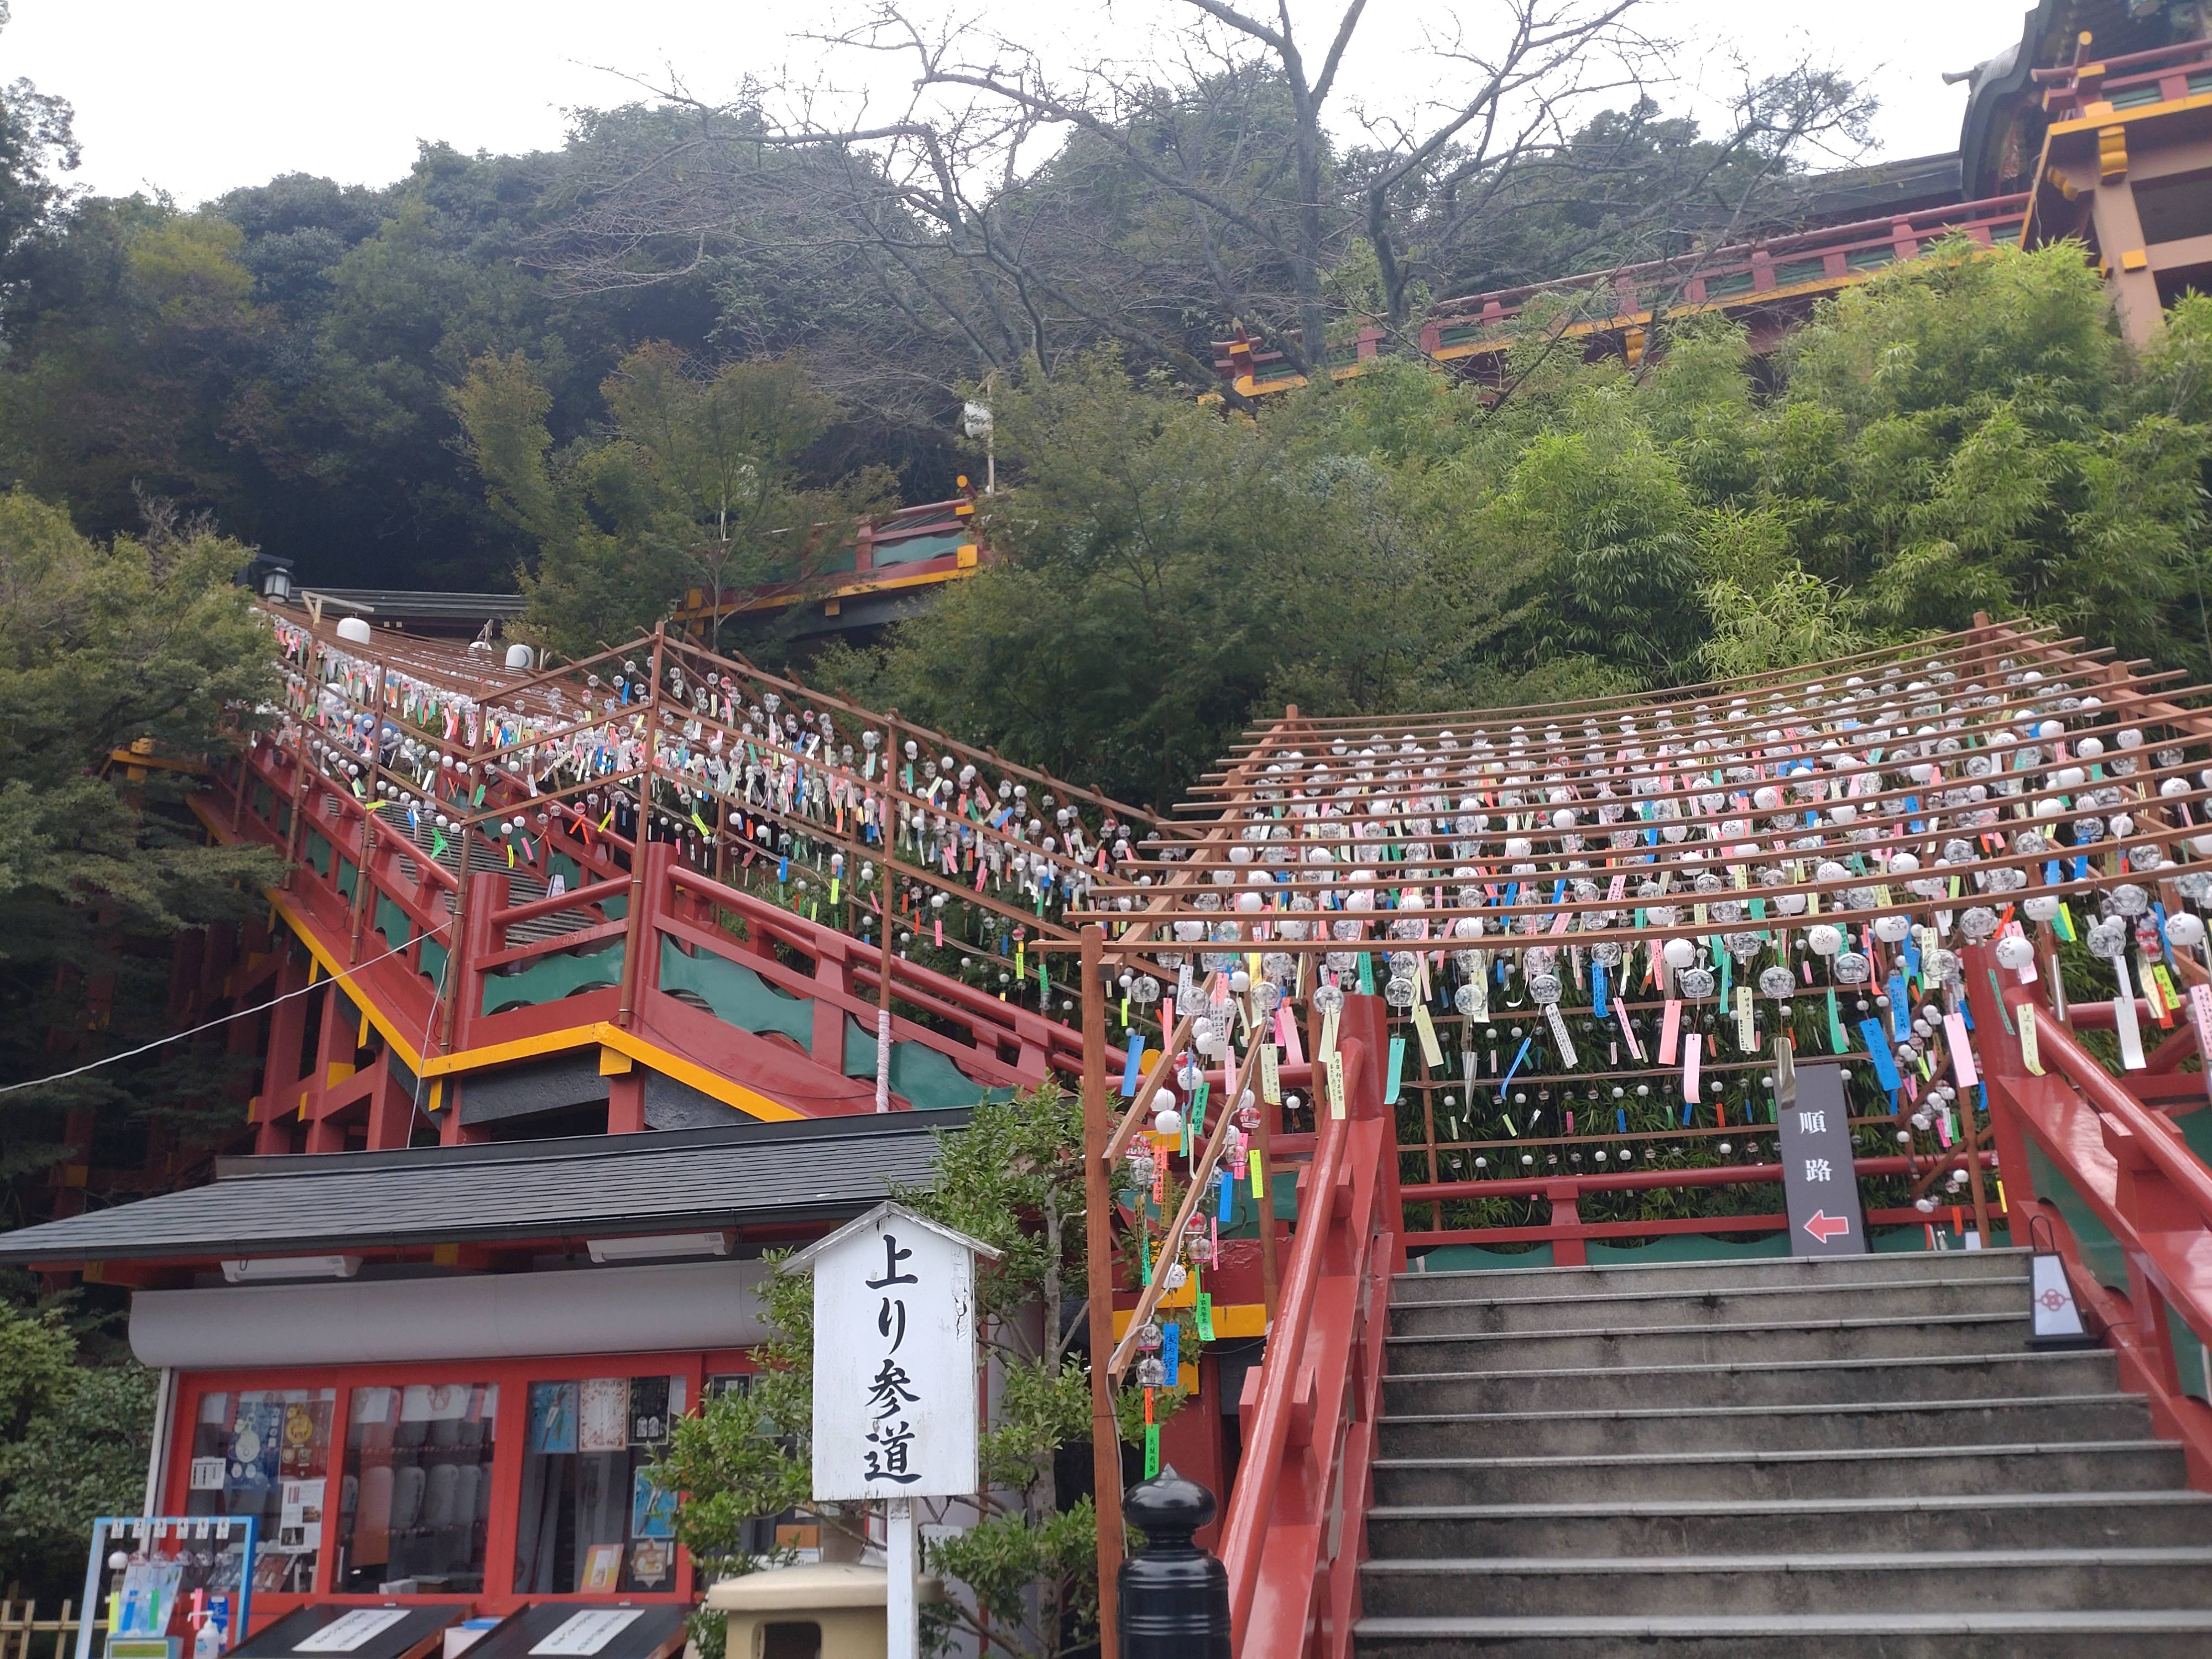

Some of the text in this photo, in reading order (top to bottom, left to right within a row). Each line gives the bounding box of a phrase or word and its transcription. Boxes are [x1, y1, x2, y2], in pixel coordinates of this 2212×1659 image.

[1799, 1110, 1833, 1182] 順路
[864, 1234, 922, 1485] 上り参道
